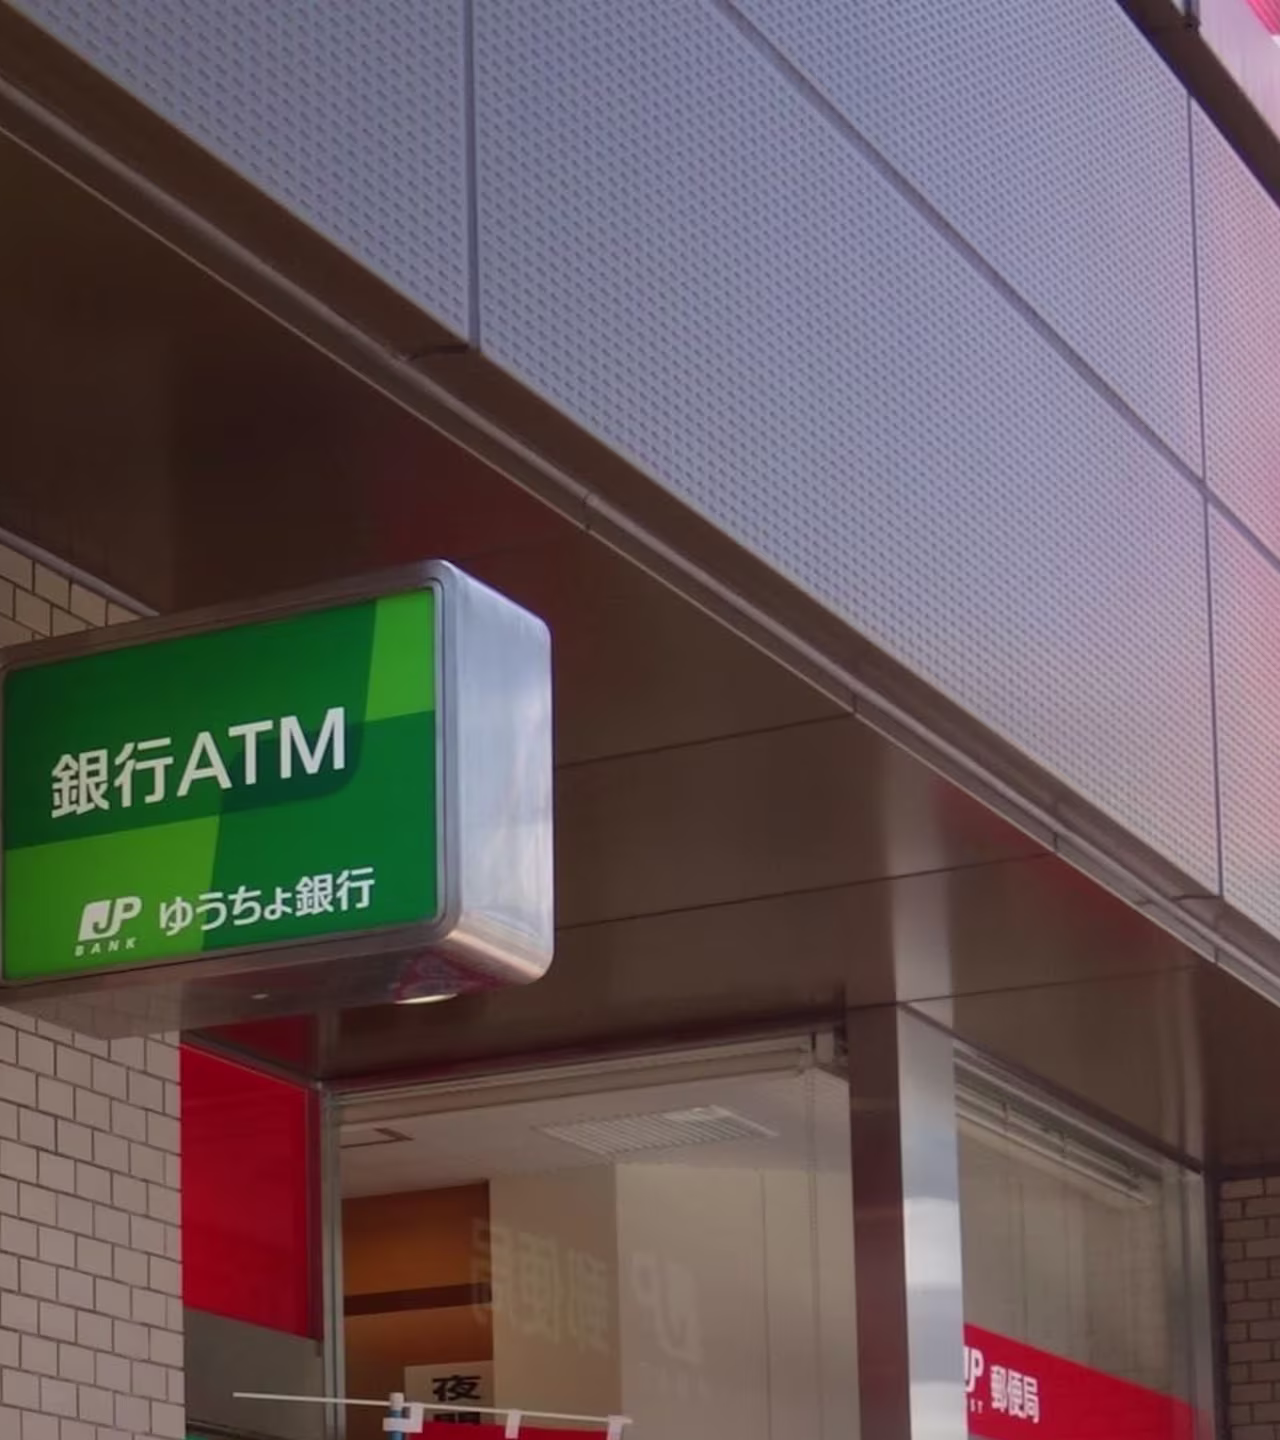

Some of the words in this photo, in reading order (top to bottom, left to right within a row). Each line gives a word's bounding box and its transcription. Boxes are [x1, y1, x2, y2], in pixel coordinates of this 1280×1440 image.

[50, 706, 347, 819] 銀行ATM
[159, 867, 376, 938] ゆうちょ銀行
[74, 936, 138, 958] BANK
[989, 1364, 1040, 1424] 郵便局
